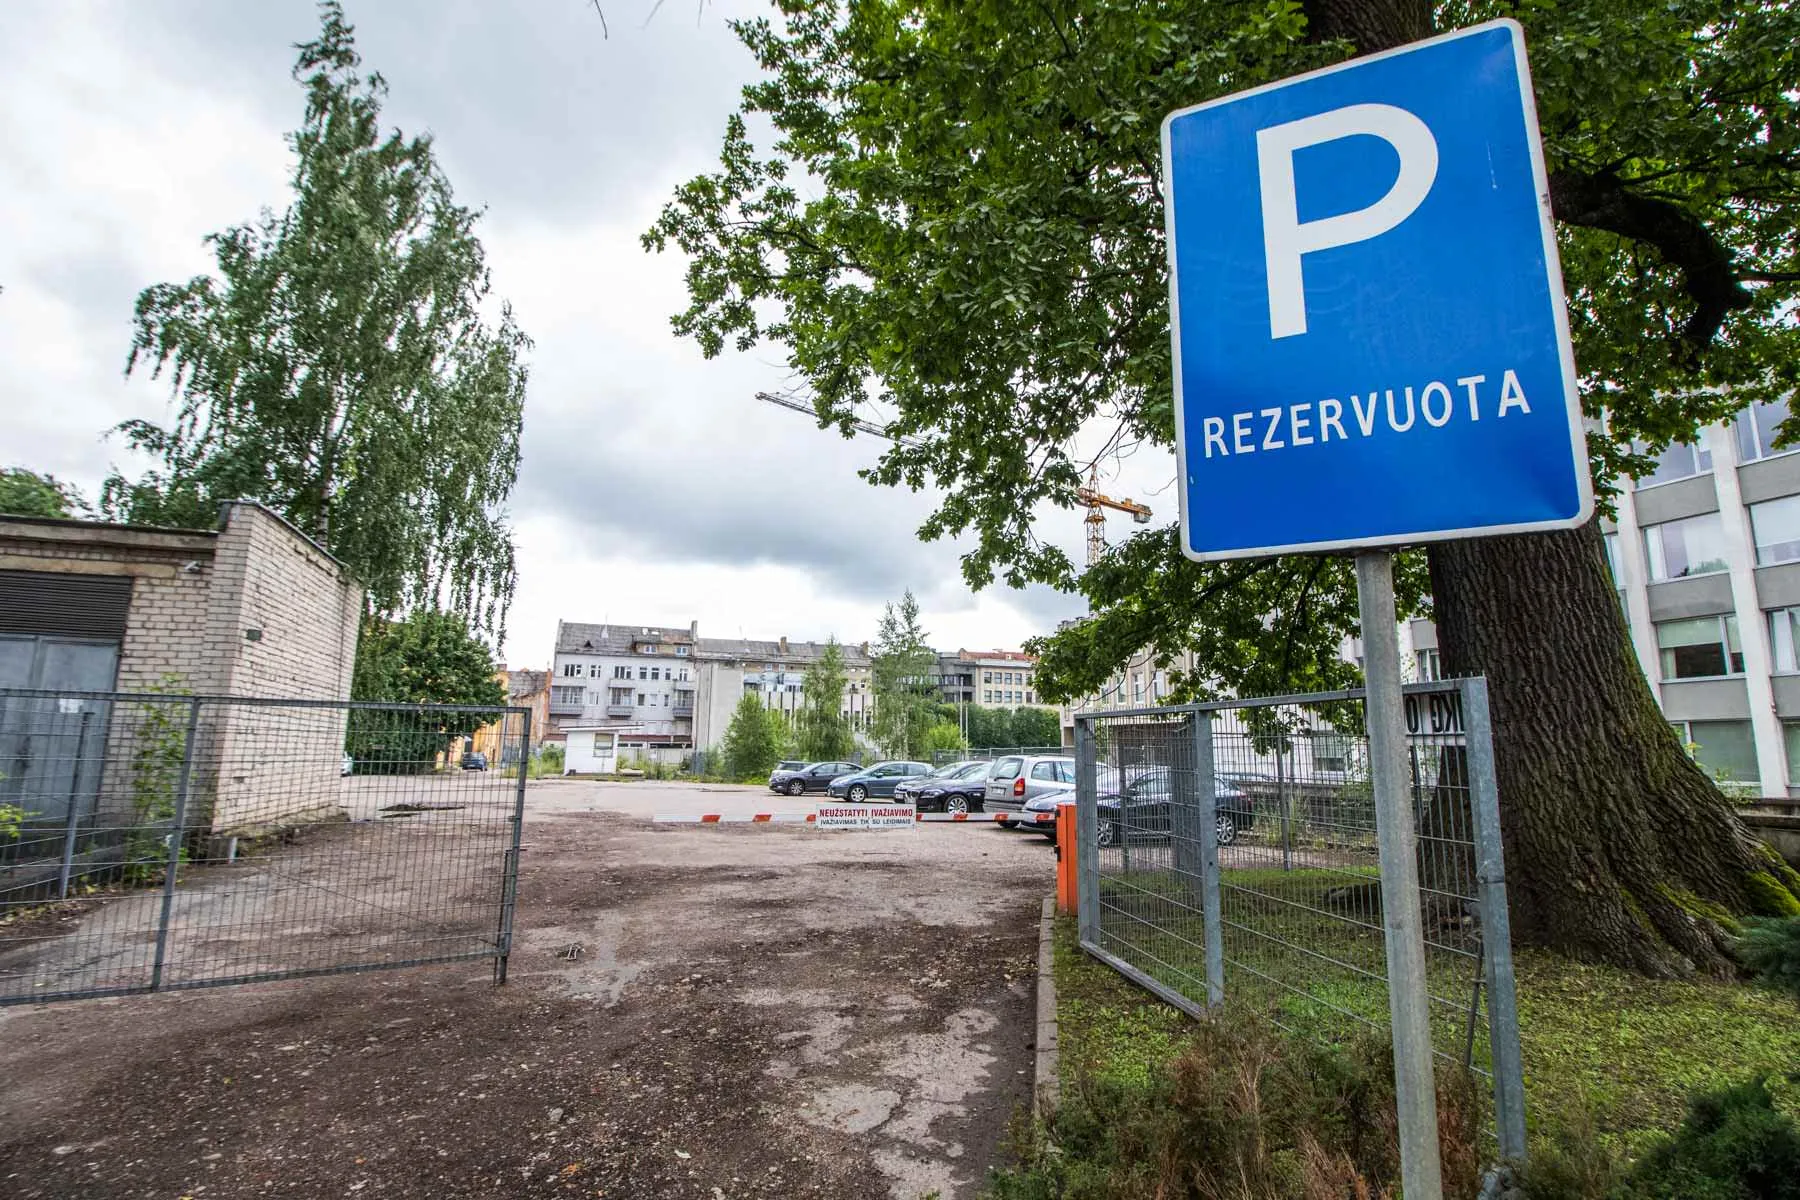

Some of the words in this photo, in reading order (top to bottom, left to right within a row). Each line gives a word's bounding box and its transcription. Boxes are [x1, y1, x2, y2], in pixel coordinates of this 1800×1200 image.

[1256, 103, 1439, 340] P
[1203, 369, 1533, 458] REZERVUOTA
[819, 808, 868, 817] NEUŽSTATYTI
[871, 808, 913, 818] ĮVAŽIAVIMO
